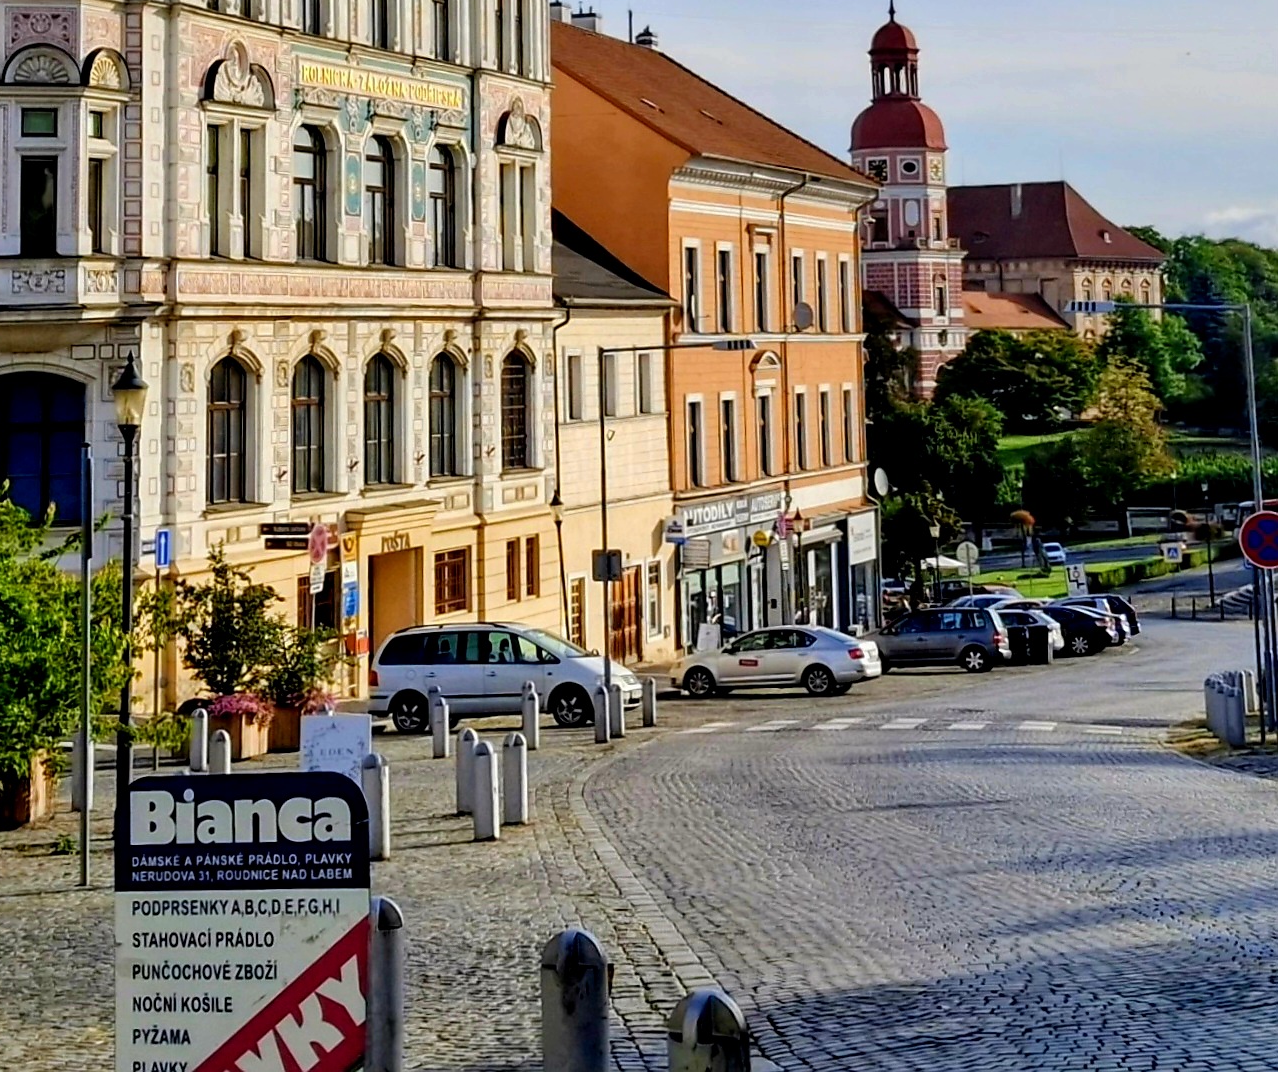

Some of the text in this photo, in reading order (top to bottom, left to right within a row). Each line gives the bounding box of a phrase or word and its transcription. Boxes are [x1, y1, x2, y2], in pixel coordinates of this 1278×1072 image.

[301, 64, 353, 89] ROLNICKÁ
[358, 71, 405, 98] ZÁLOŽNA
[381, 530, 410, 553] POŠTA
[319, 747, 354, 756] EDEN
[130, 788, 352, 846] Bianca
[132, 851, 352, 867] DÁMSKÉ A PÁNSKÉ PRÁDLO, PLAVKY
[132, 868, 353, 883] NERUDOVA 31, ROUDNICE NAD LABEM
[132, 900, 229, 917] PODPRSENKY
[132, 928, 275, 948] STAHOVACÍ PRÁDLO
[132, 959, 278, 980] PUNČOCHOVÉ ZBOŽÍ
[132, 992, 233, 1013] NOČNÍ KOŠILE
[132, 1024, 191, 1045] PYŽAMA
[132, 1061, 188, 1072] PLAVKY
